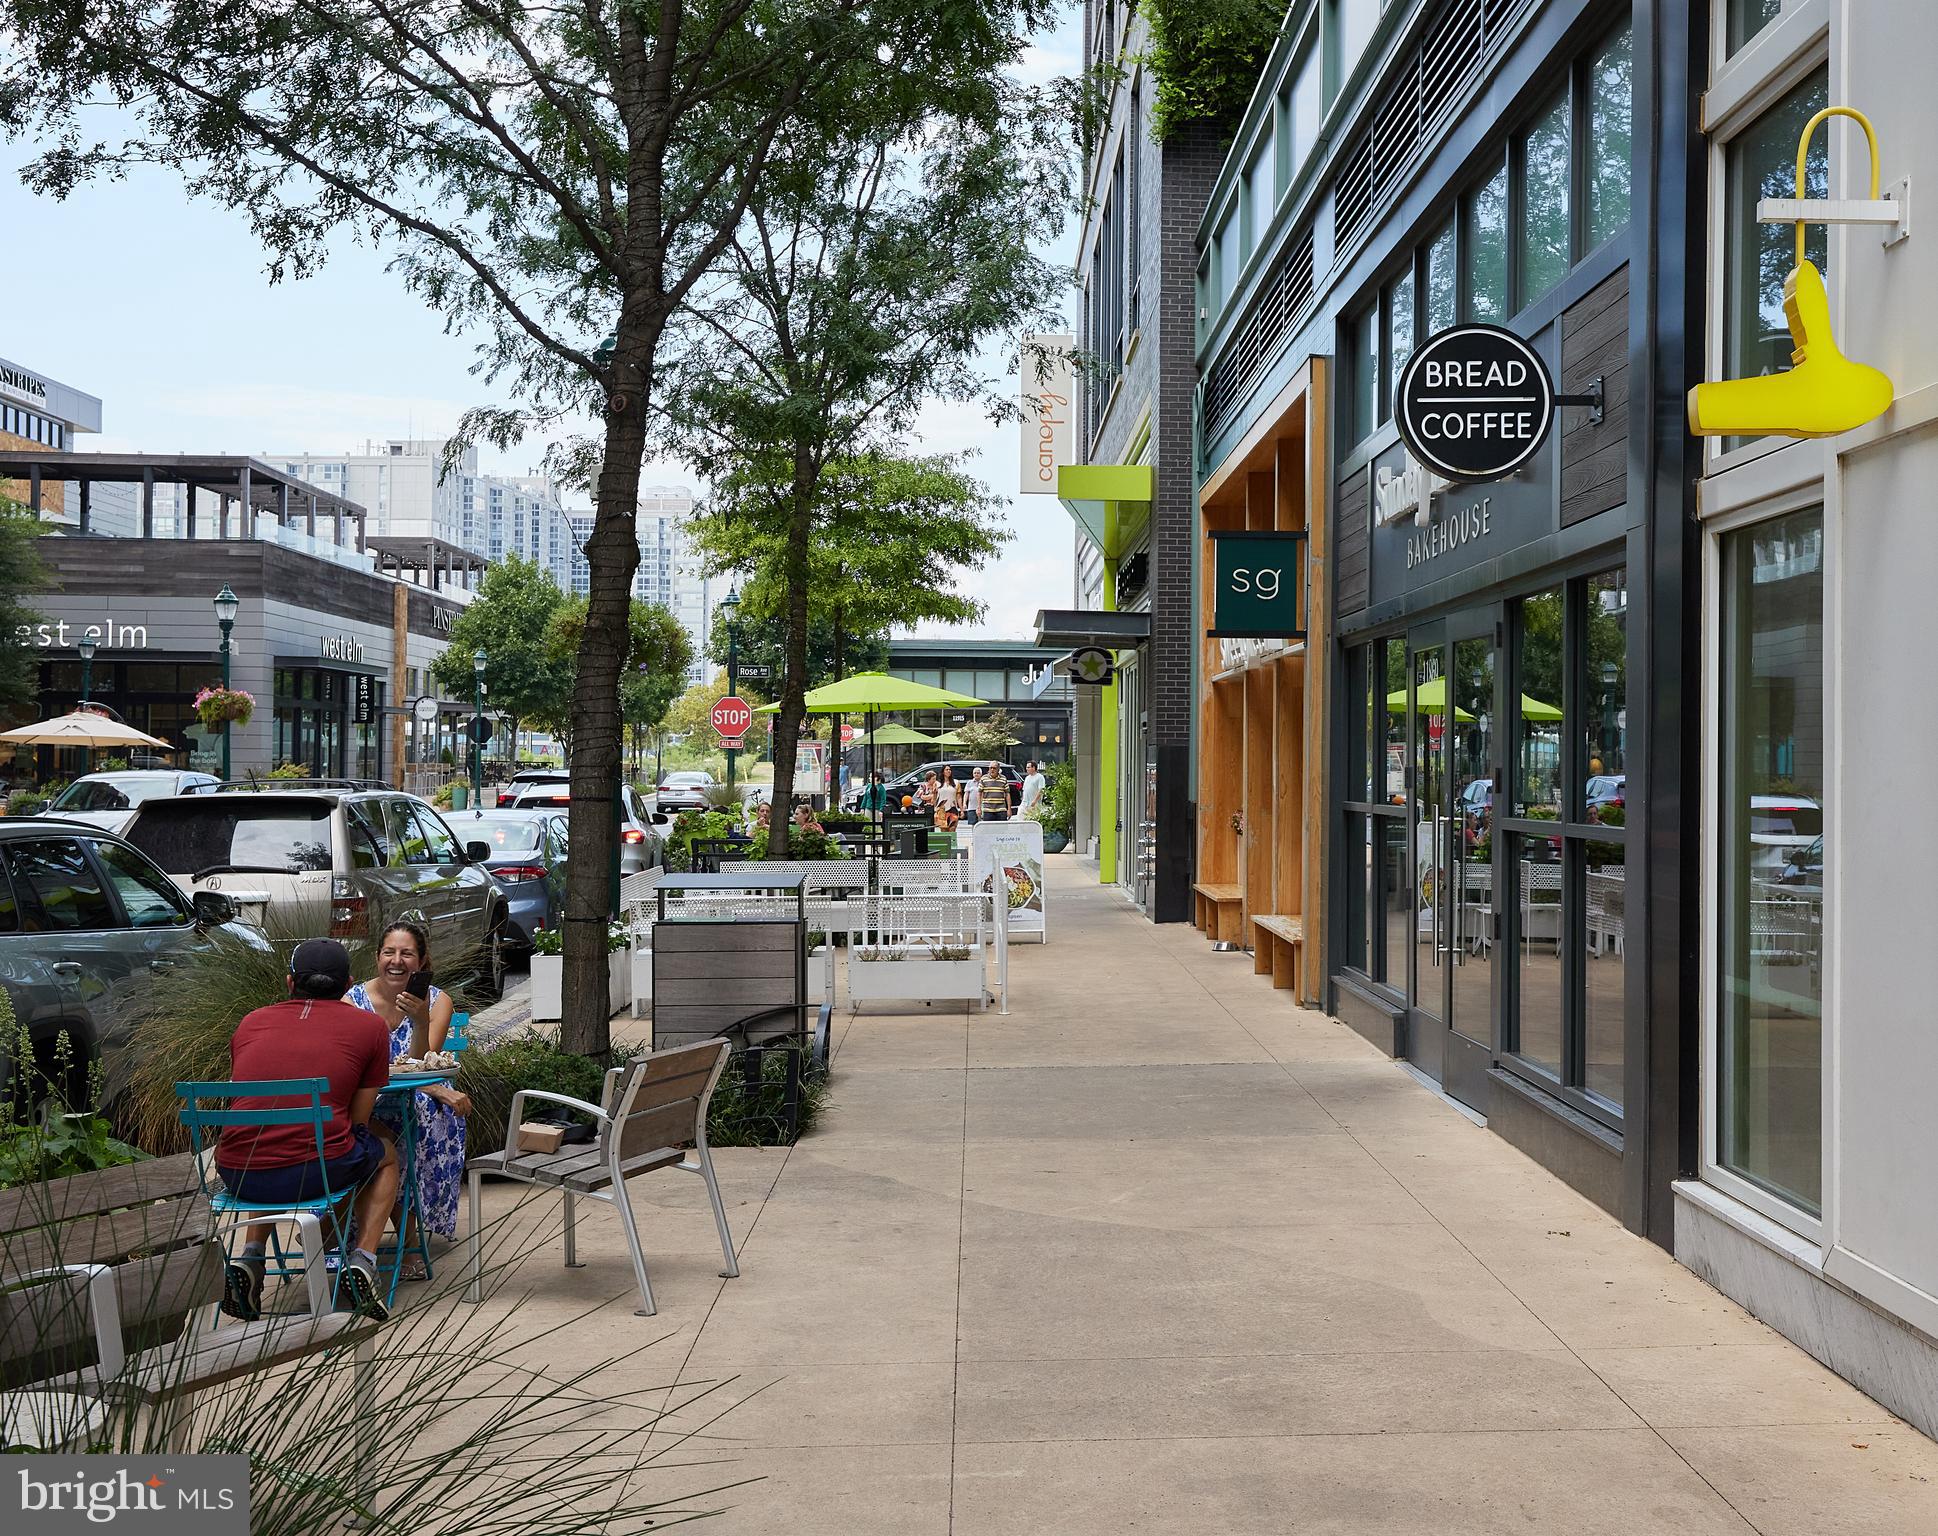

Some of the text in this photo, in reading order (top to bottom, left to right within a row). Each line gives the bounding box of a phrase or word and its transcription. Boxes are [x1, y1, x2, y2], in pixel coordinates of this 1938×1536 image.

[1425, 360, 1527, 388] BREAD
[1039, 385, 1068, 482] canopy
[1421, 412, 1532, 440] COFFEE
[1407, 497, 1491, 570] BAKEHOUSE
[1231, 568, 1282, 600] sg
[14, 618, 148, 648] est elm
[321, 635, 364, 663] west elm
[740, 667, 758, 676] Rose
[360, 676, 369, 721] west elm
[714, 709, 749, 725] STOP
[301, 875, 327, 884] MDX
